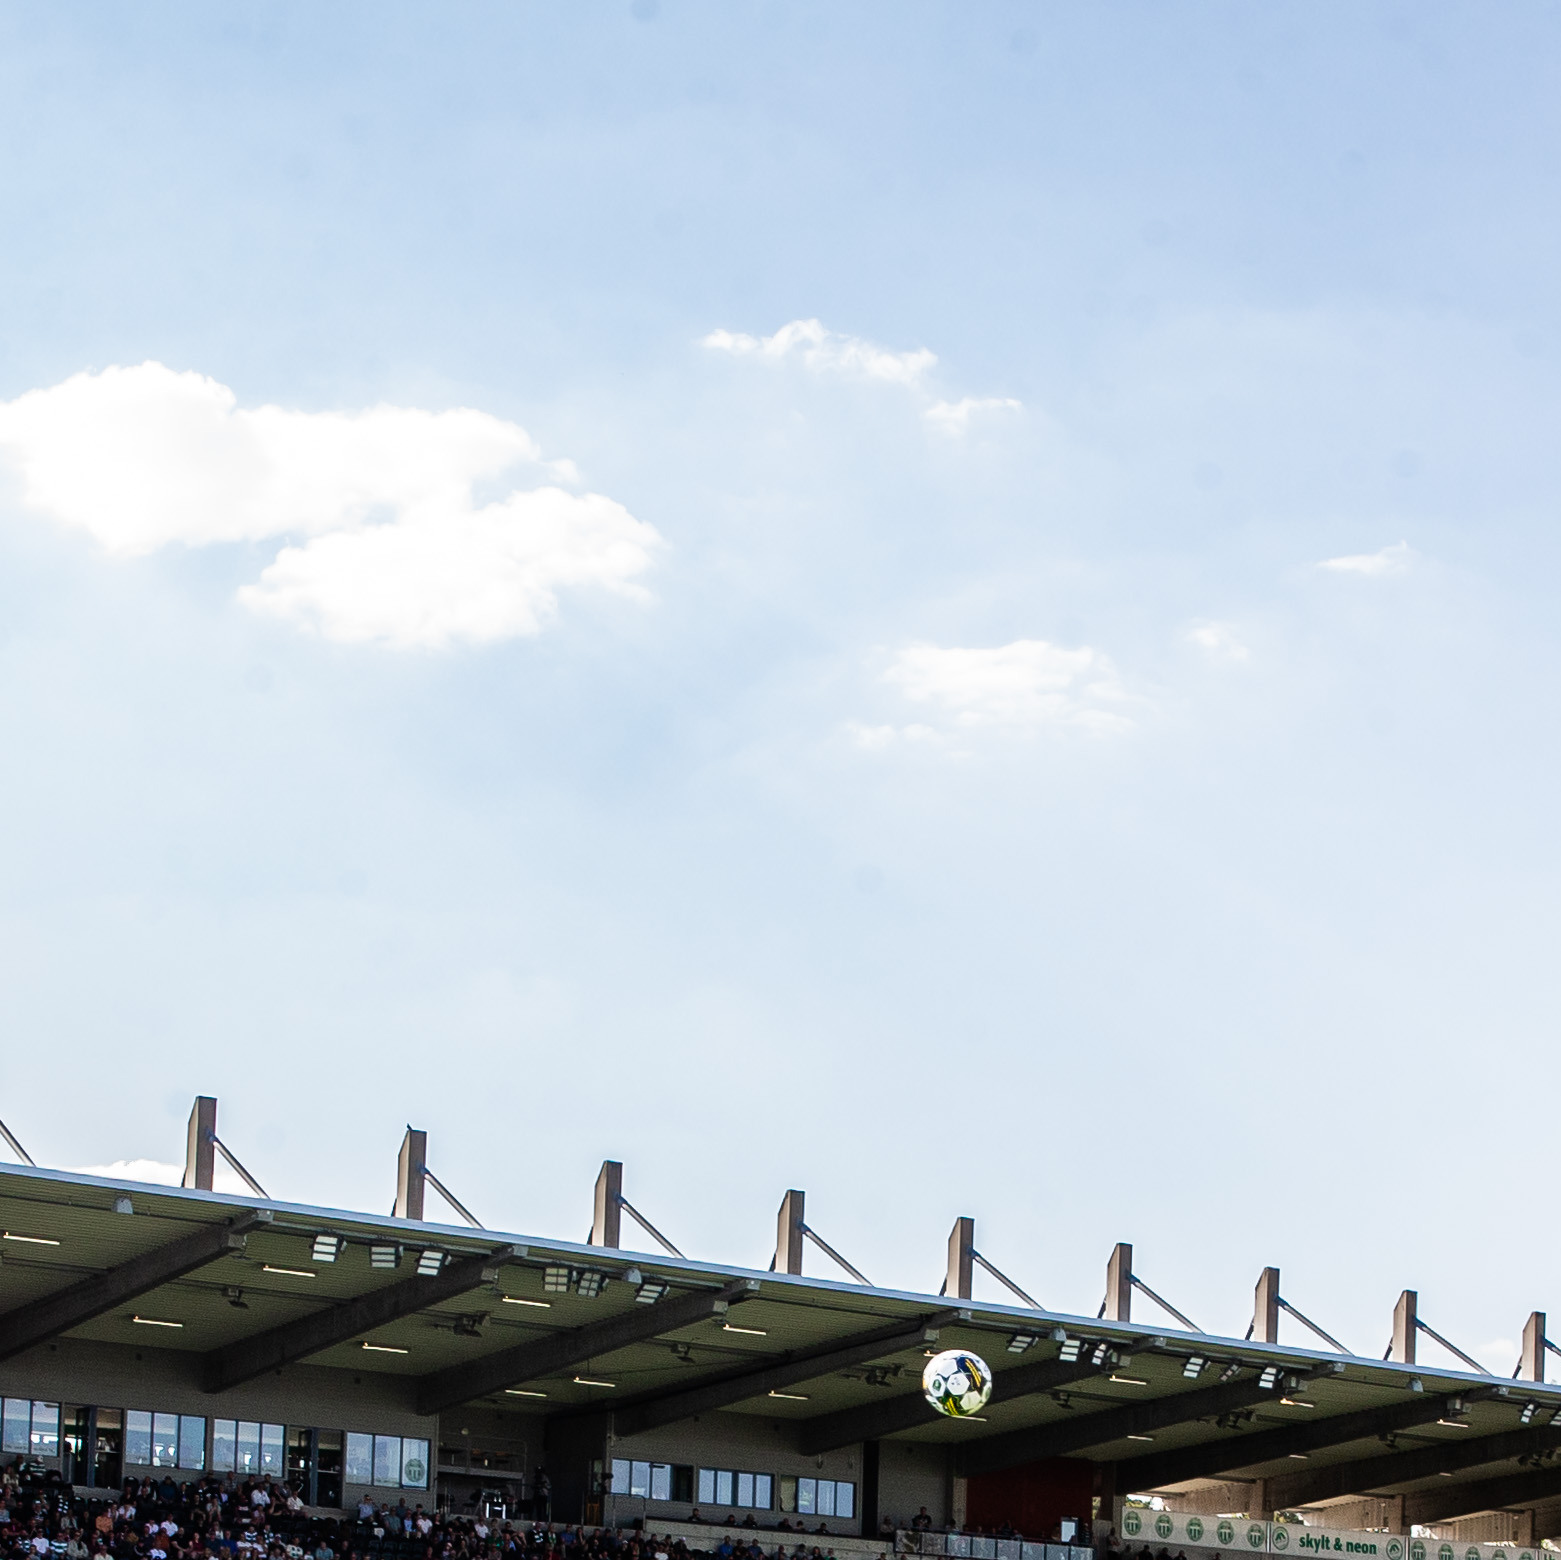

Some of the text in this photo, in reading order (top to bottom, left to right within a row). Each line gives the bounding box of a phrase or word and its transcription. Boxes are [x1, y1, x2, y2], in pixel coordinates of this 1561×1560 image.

[1298, 1532, 1378, 1555] skylt & neon
